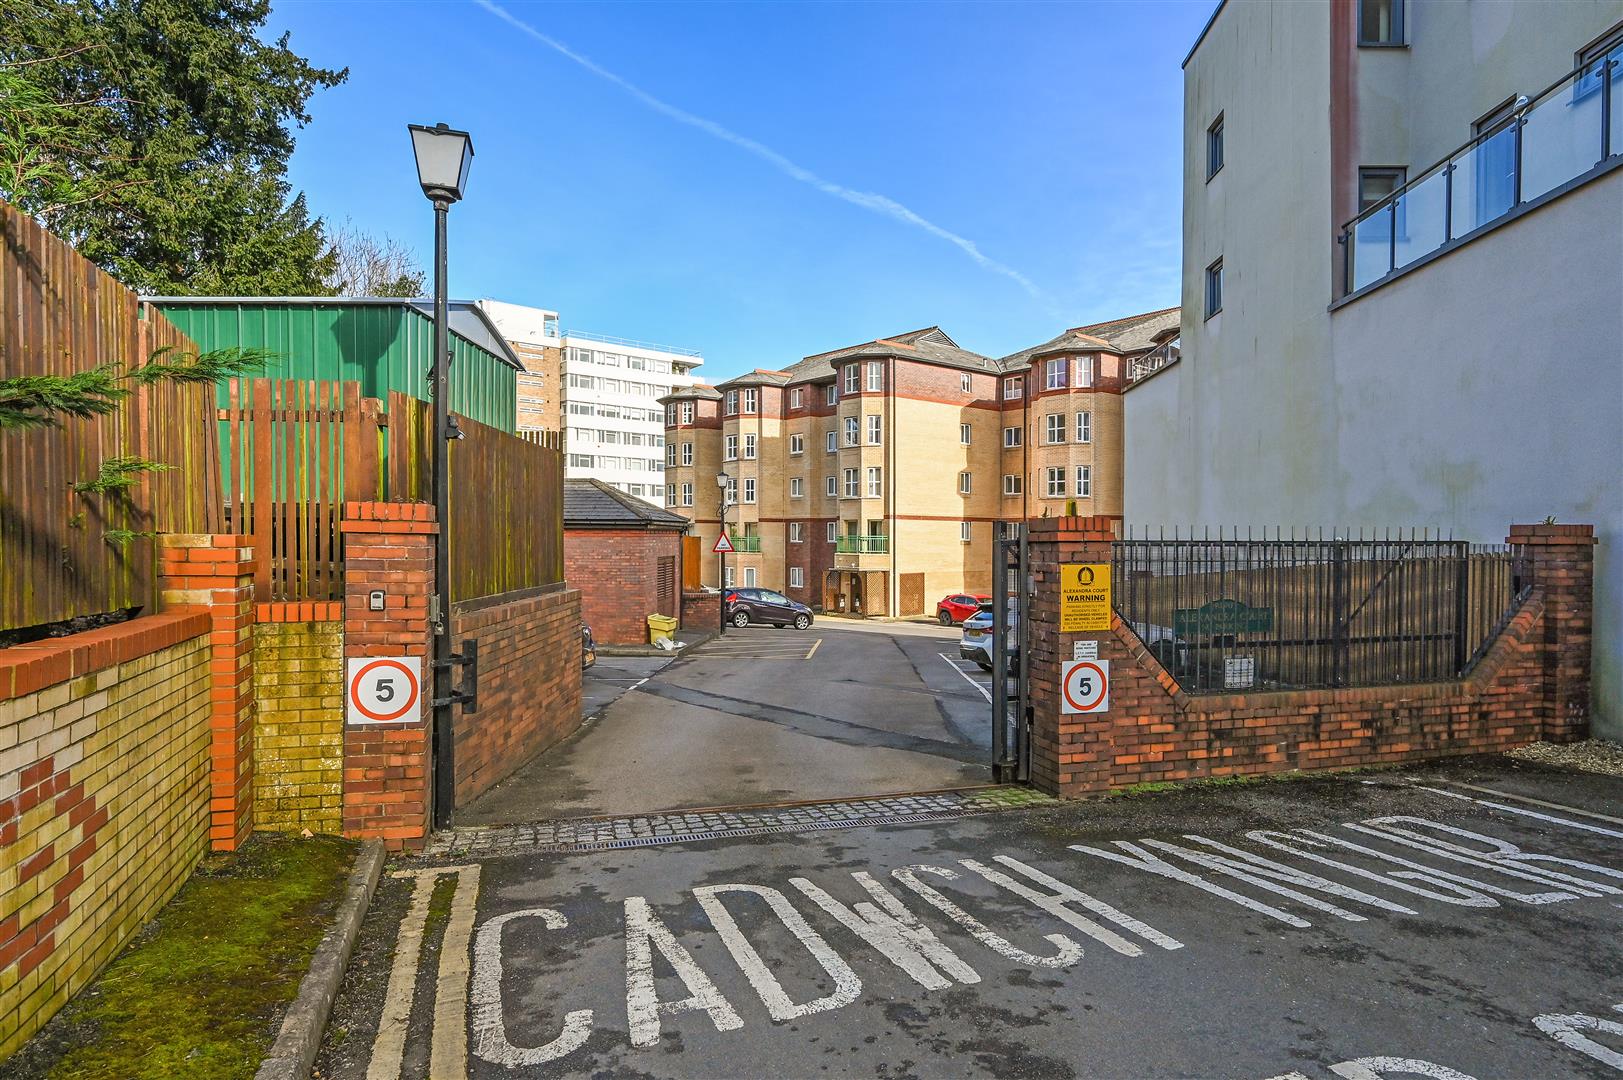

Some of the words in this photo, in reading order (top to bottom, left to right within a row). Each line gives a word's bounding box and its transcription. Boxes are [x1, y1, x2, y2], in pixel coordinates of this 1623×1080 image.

[375, 679, 394, 702] 5
[1080, 678, 1091, 696] 5
[471, 853, 1185, 1068] CADWCH
[1067, 834, 1418, 928] YN
